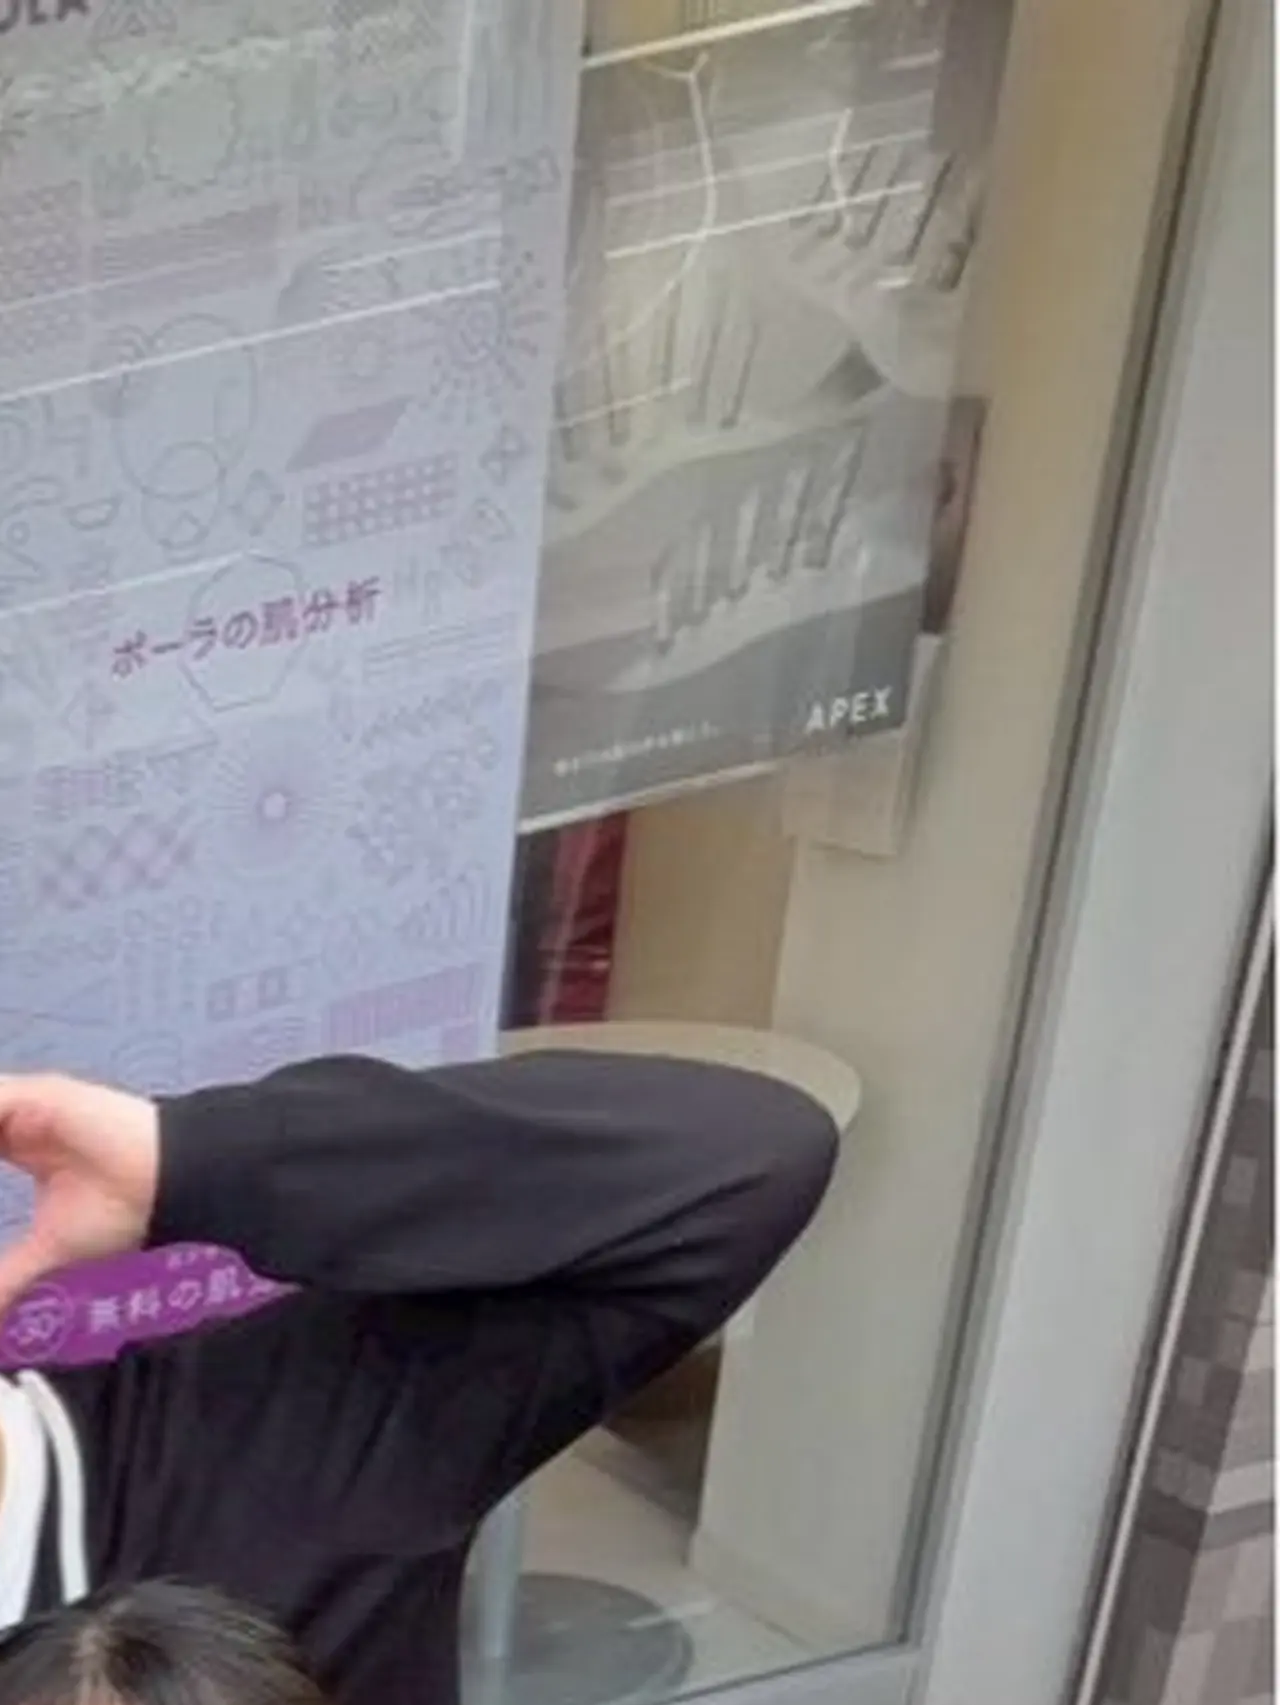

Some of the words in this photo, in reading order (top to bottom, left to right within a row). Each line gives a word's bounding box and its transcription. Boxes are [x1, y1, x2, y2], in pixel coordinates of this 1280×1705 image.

[111, 575, 383, 679] ポーラの肌分析
[804, 684, 893, 736] APEX
